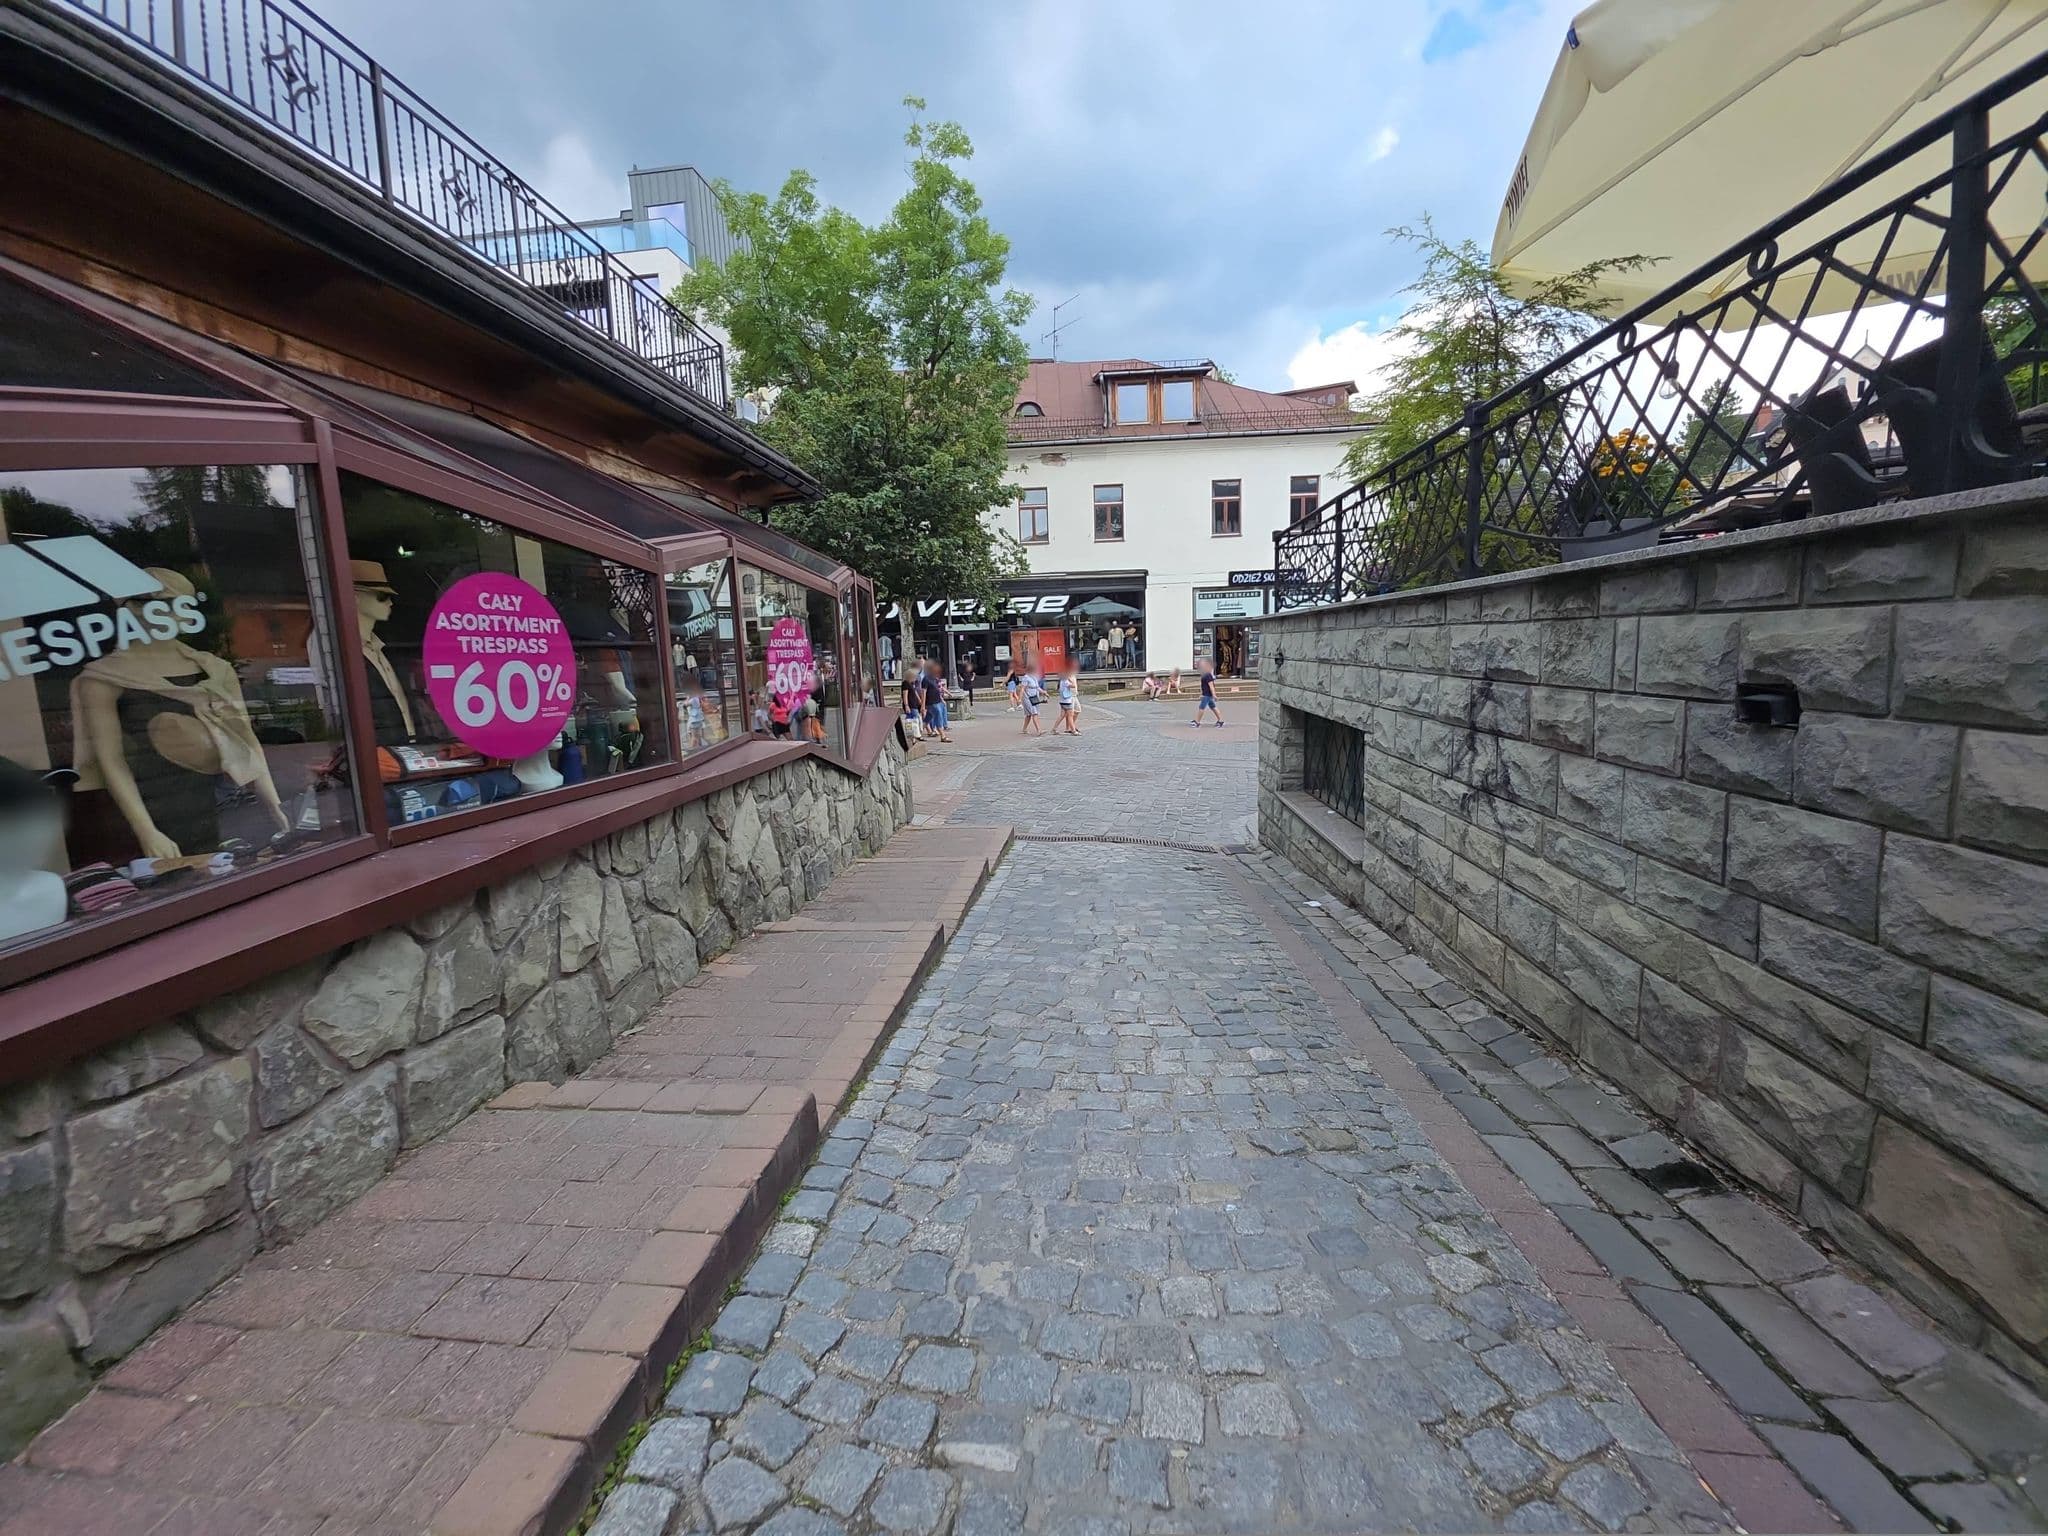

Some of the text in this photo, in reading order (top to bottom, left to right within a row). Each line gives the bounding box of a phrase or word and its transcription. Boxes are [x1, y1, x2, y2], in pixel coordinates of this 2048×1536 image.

[478, 592, 522, 612] CAŁY
[436, 612, 561, 634] ASORTYMENT
[457, 635, 548, 654] TRESPASS
[776, 649, 804, 658] TRESPASS
[430, 660, 571, 728] -60%
